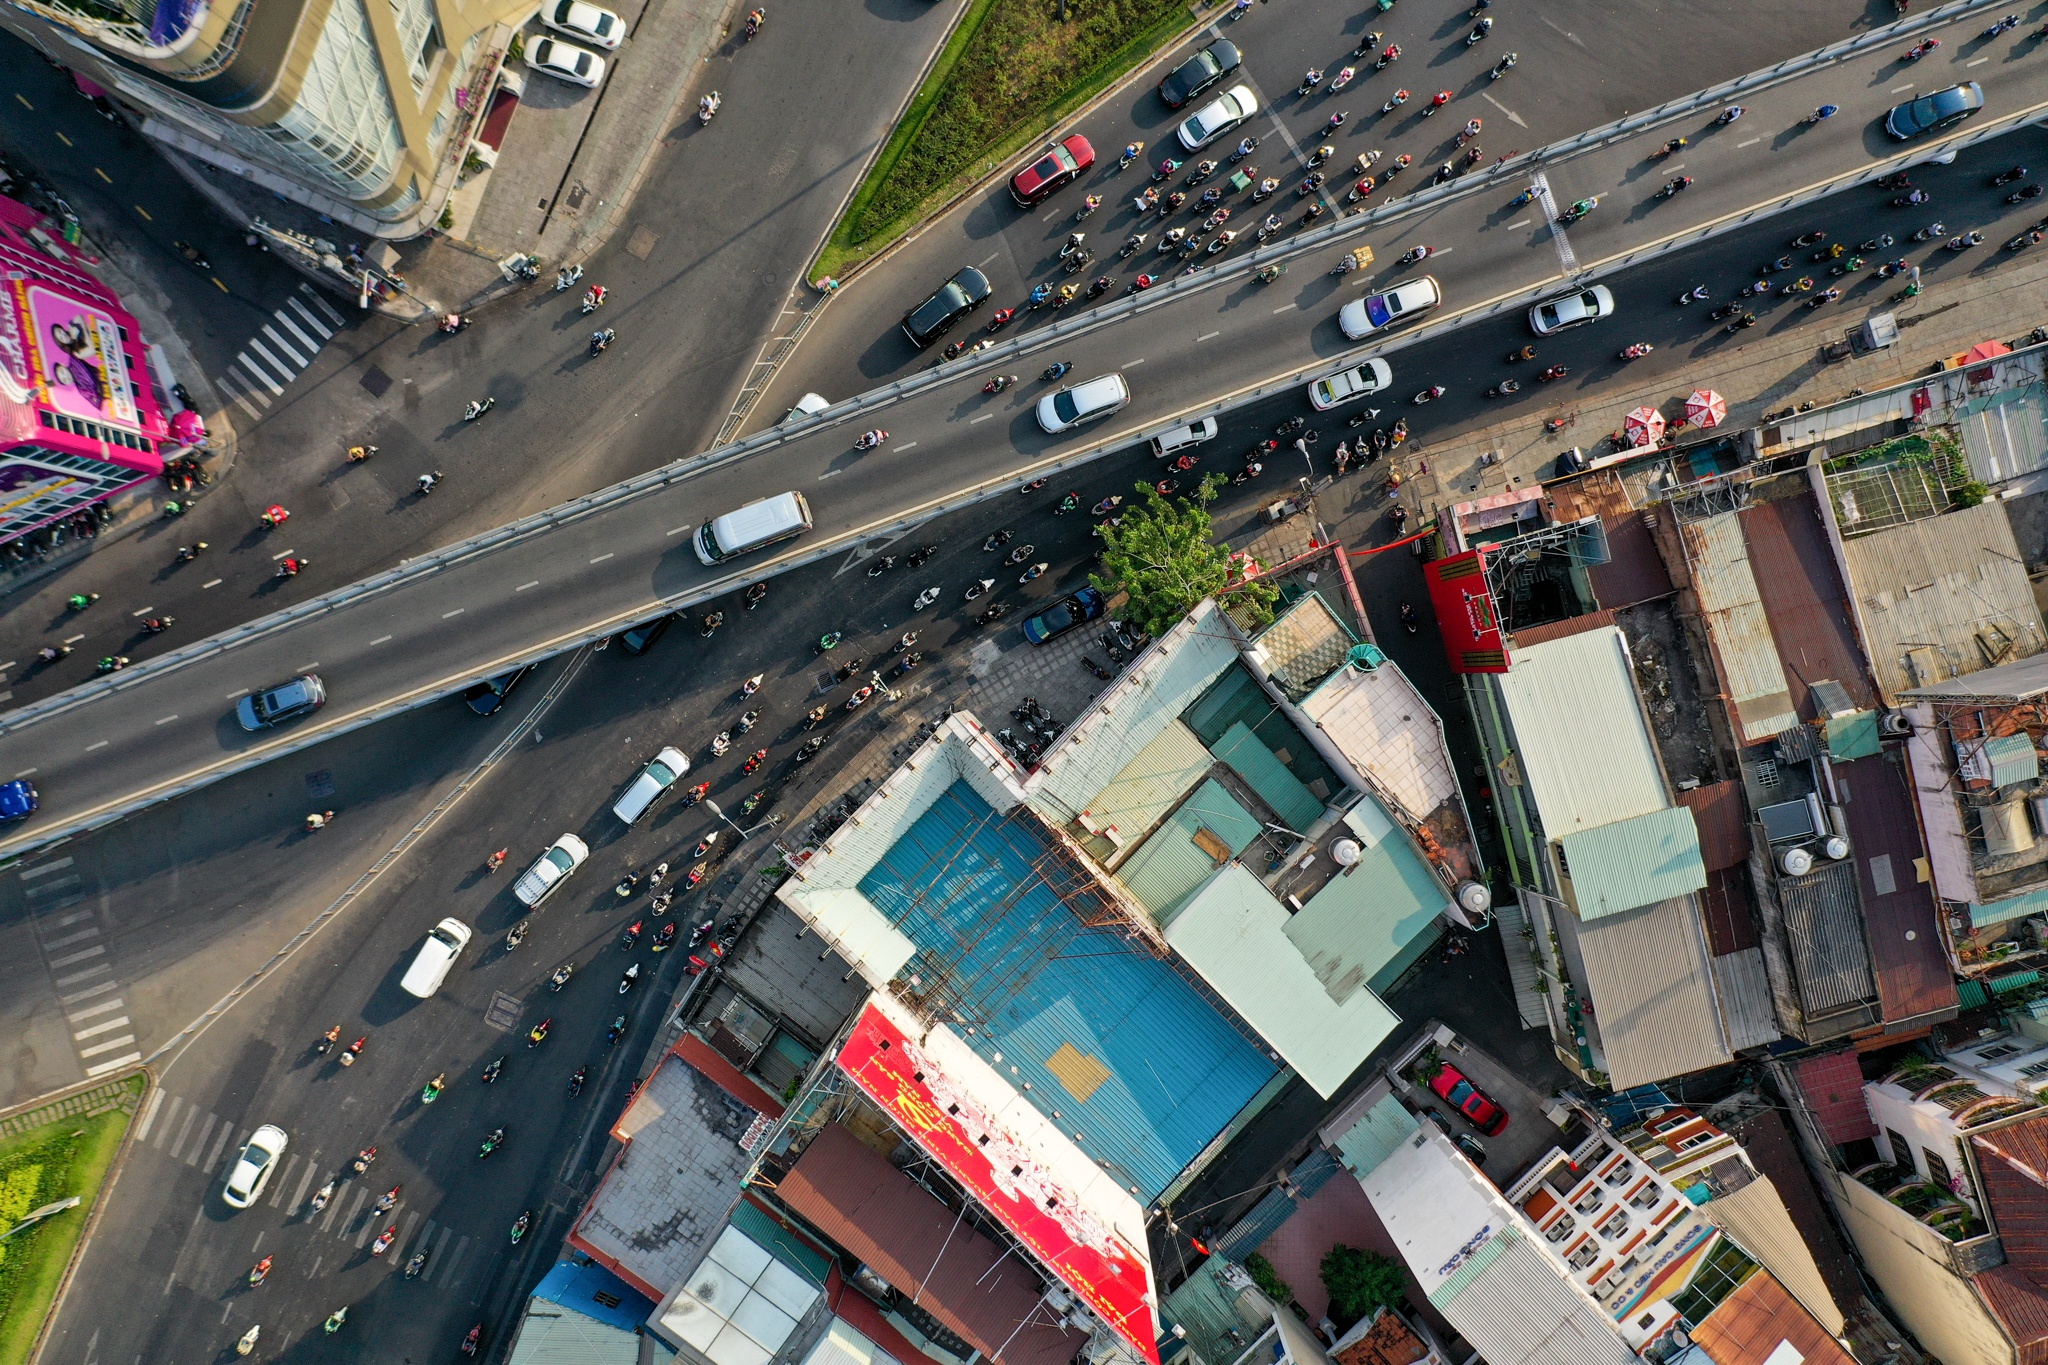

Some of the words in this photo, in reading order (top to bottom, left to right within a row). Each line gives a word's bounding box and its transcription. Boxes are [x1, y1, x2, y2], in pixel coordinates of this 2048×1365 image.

[0, 289, 28, 380] CHARME
[918, 1130, 948, 1161] VINH
[950, 1160, 991, 1201] QUANG
[993, 1202, 1019, 1230] NAM
[1673, 1224, 1702, 1251] SONG
[1625, 1287, 1634, 1296] &
